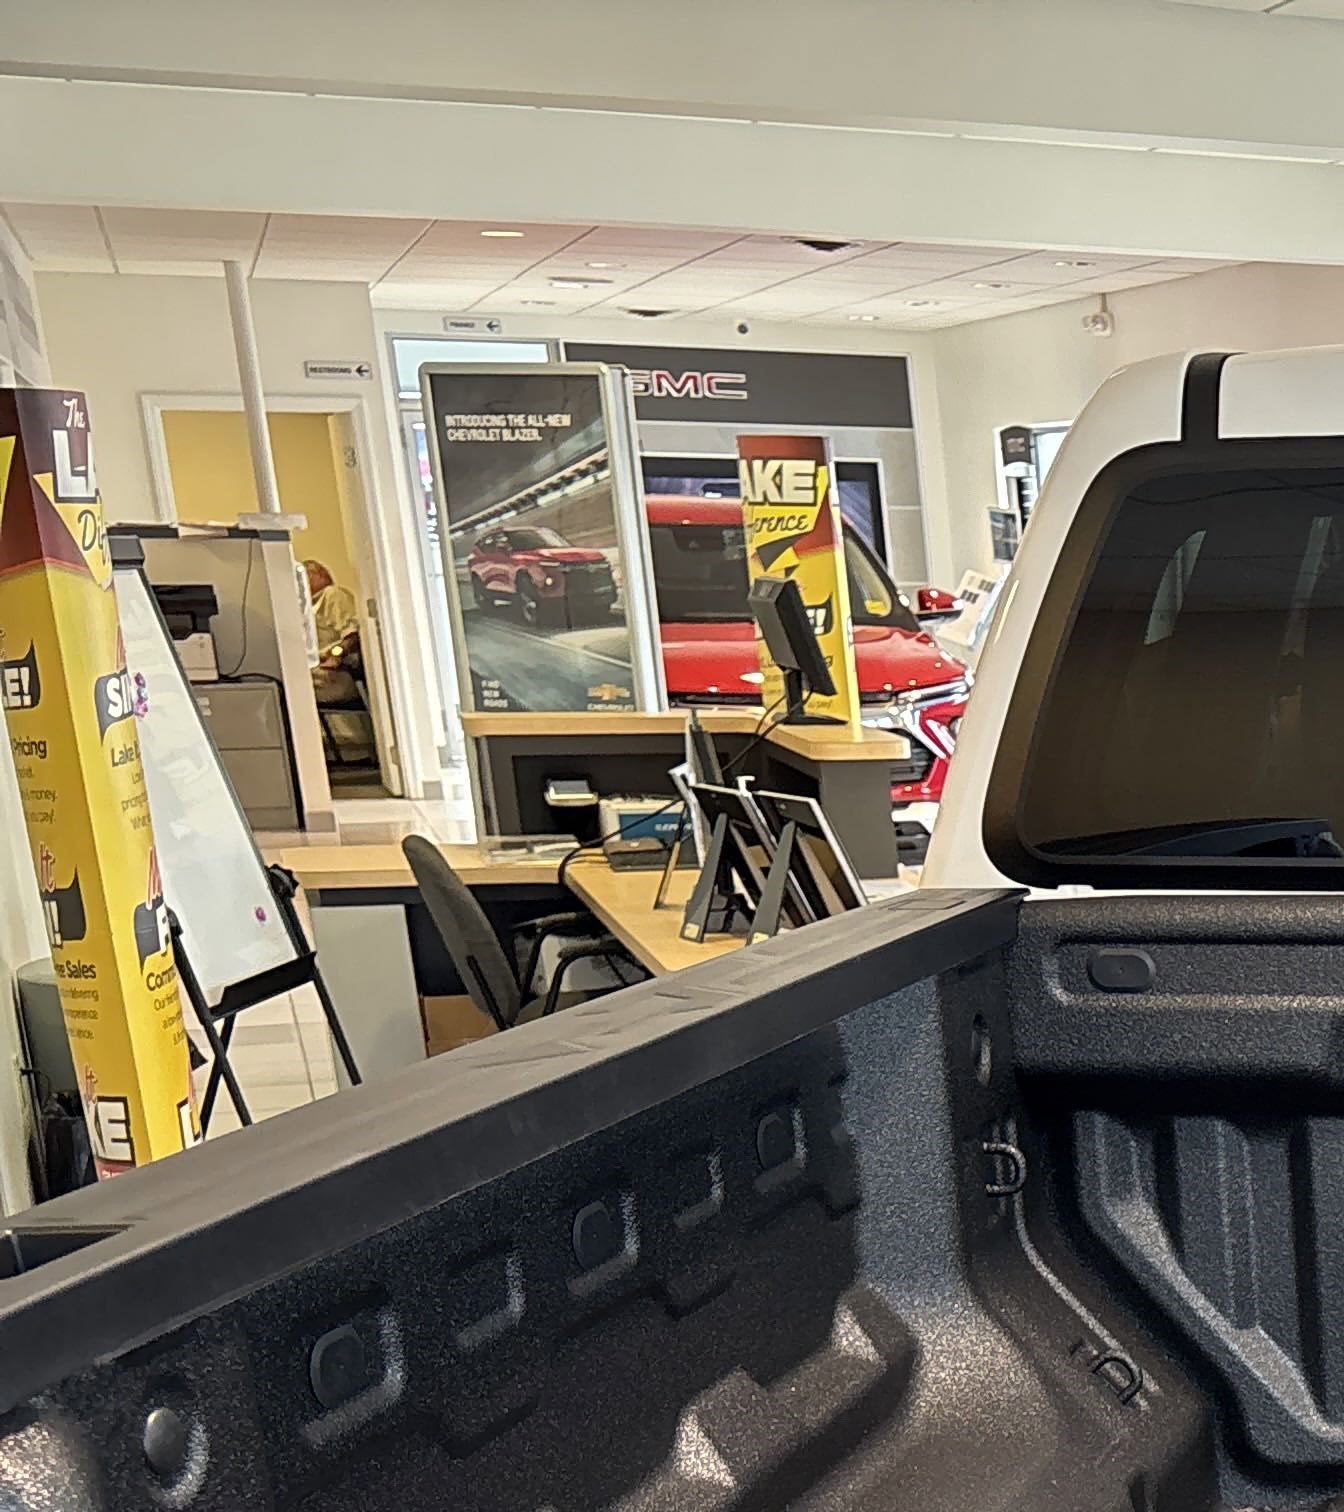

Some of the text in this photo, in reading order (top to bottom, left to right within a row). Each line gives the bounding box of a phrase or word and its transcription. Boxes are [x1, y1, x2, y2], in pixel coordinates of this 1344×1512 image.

[445, 414, 571, 427] INTRODUCING THE ALL-NEW
[447, 428, 500, 441] CHEVROLET
[66, 960, 96, 980] Sales
